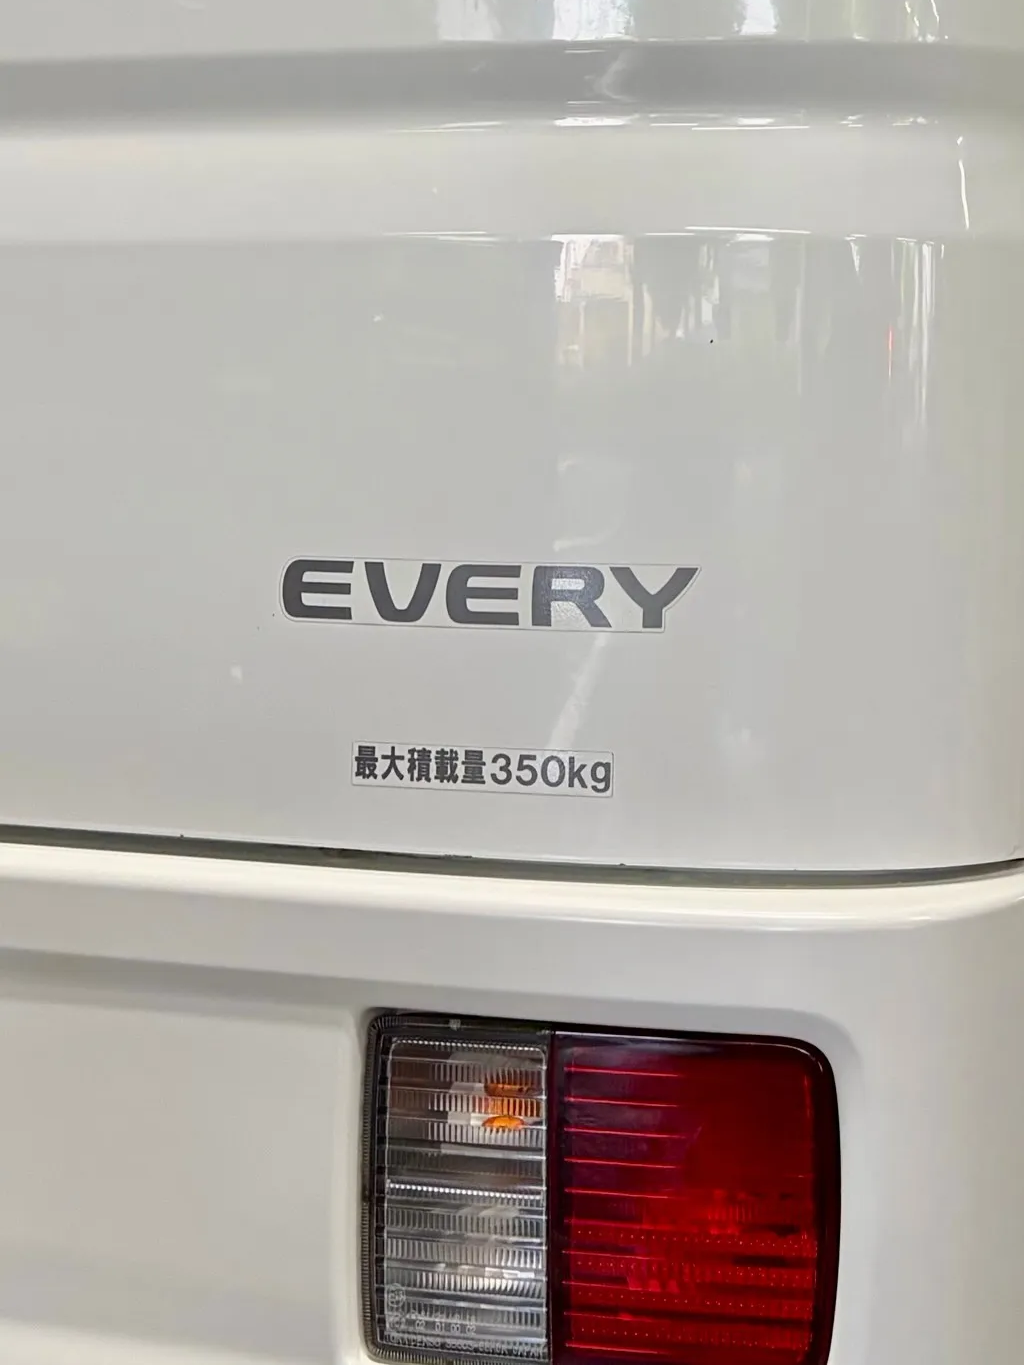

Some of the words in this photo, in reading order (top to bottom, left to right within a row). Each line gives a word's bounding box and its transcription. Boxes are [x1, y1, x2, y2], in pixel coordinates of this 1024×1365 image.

[282, 559, 699, 629] EVERY
[354, 744, 612, 793] 最大積載量350kg
